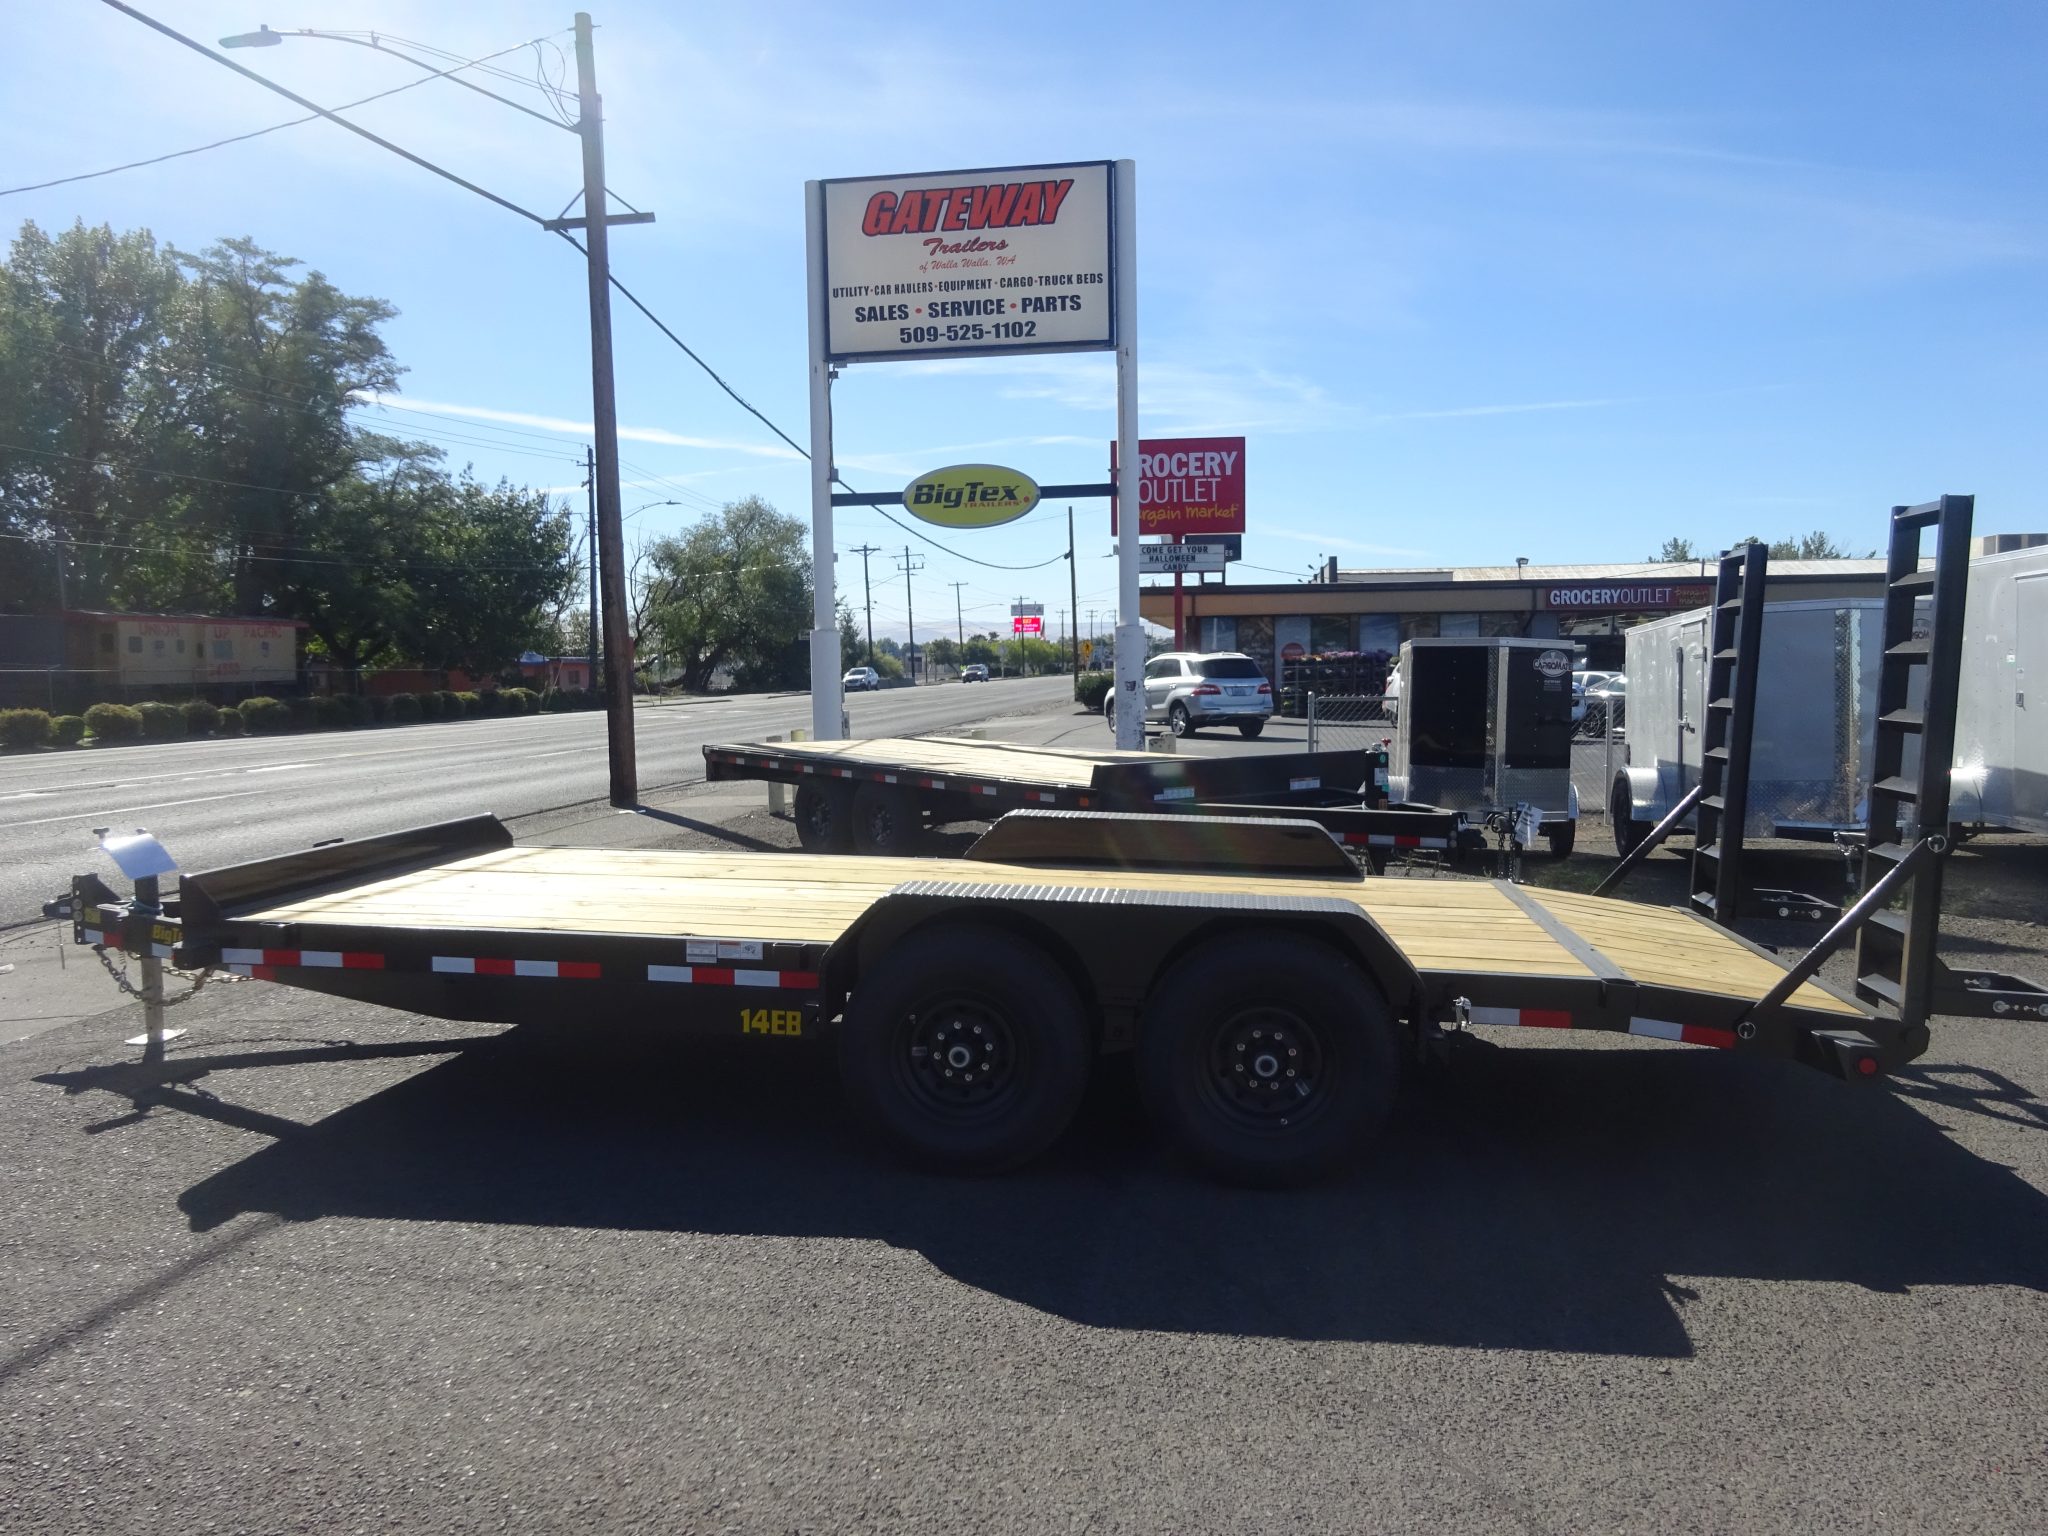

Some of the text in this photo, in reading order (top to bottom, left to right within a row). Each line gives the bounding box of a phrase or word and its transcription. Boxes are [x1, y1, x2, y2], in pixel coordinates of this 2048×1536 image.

[862, 178, 1074, 237] GATEWAY
[923, 237, 1008, 256] Trailers
[919, 262, 928, 273] of
[931, 260, 958, 270] Walla
[996, 255, 1016, 266] WA
[832, 272, 1104, 298] UTILITY CAR HAULERS EQUIPMENT CARGO TRUCK BEDS
[855, 294, 1082, 322] SALES SERVICE PARTS
[899, 321, 1037, 343] 509-525-1102
[1139, 451, 1238, 478] ROCERY
[964, 500, 1020, 508] TRAILERS
[1141, 546, 1163, 554] COME
[1186, 545, 1209, 553] YOUR
[1149, 554, 1196, 562] HALLOWEEN
[1162, 563, 1189, 571] CANDY
[138, 622, 180, 637] UNION
[740, 1009, 802, 1036] 14EB
